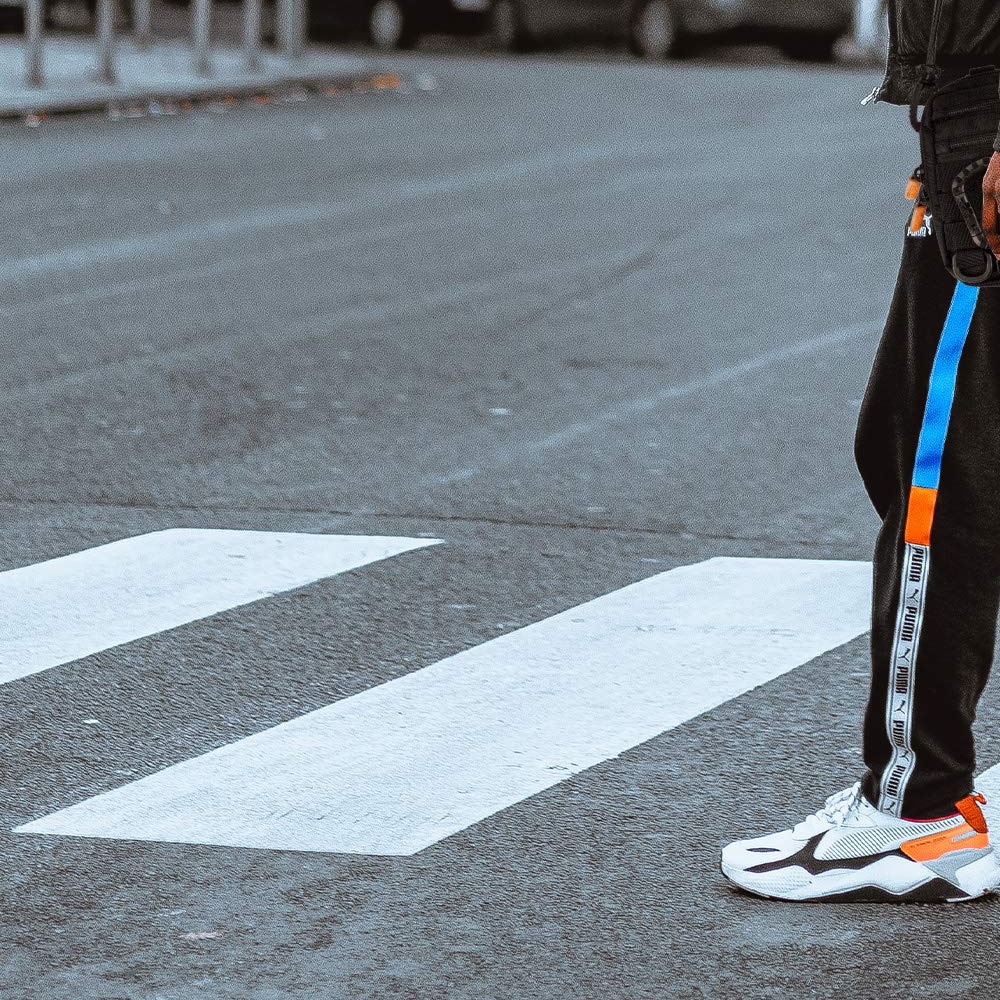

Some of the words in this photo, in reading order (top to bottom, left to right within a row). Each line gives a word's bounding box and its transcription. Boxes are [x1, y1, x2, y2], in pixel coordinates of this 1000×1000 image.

[909, 546, 924, 582] PUMA
[901, 606, 917, 642] PUMA
[895, 665, 909, 694] PUMA
[886, 764, 906, 797] PUMA
